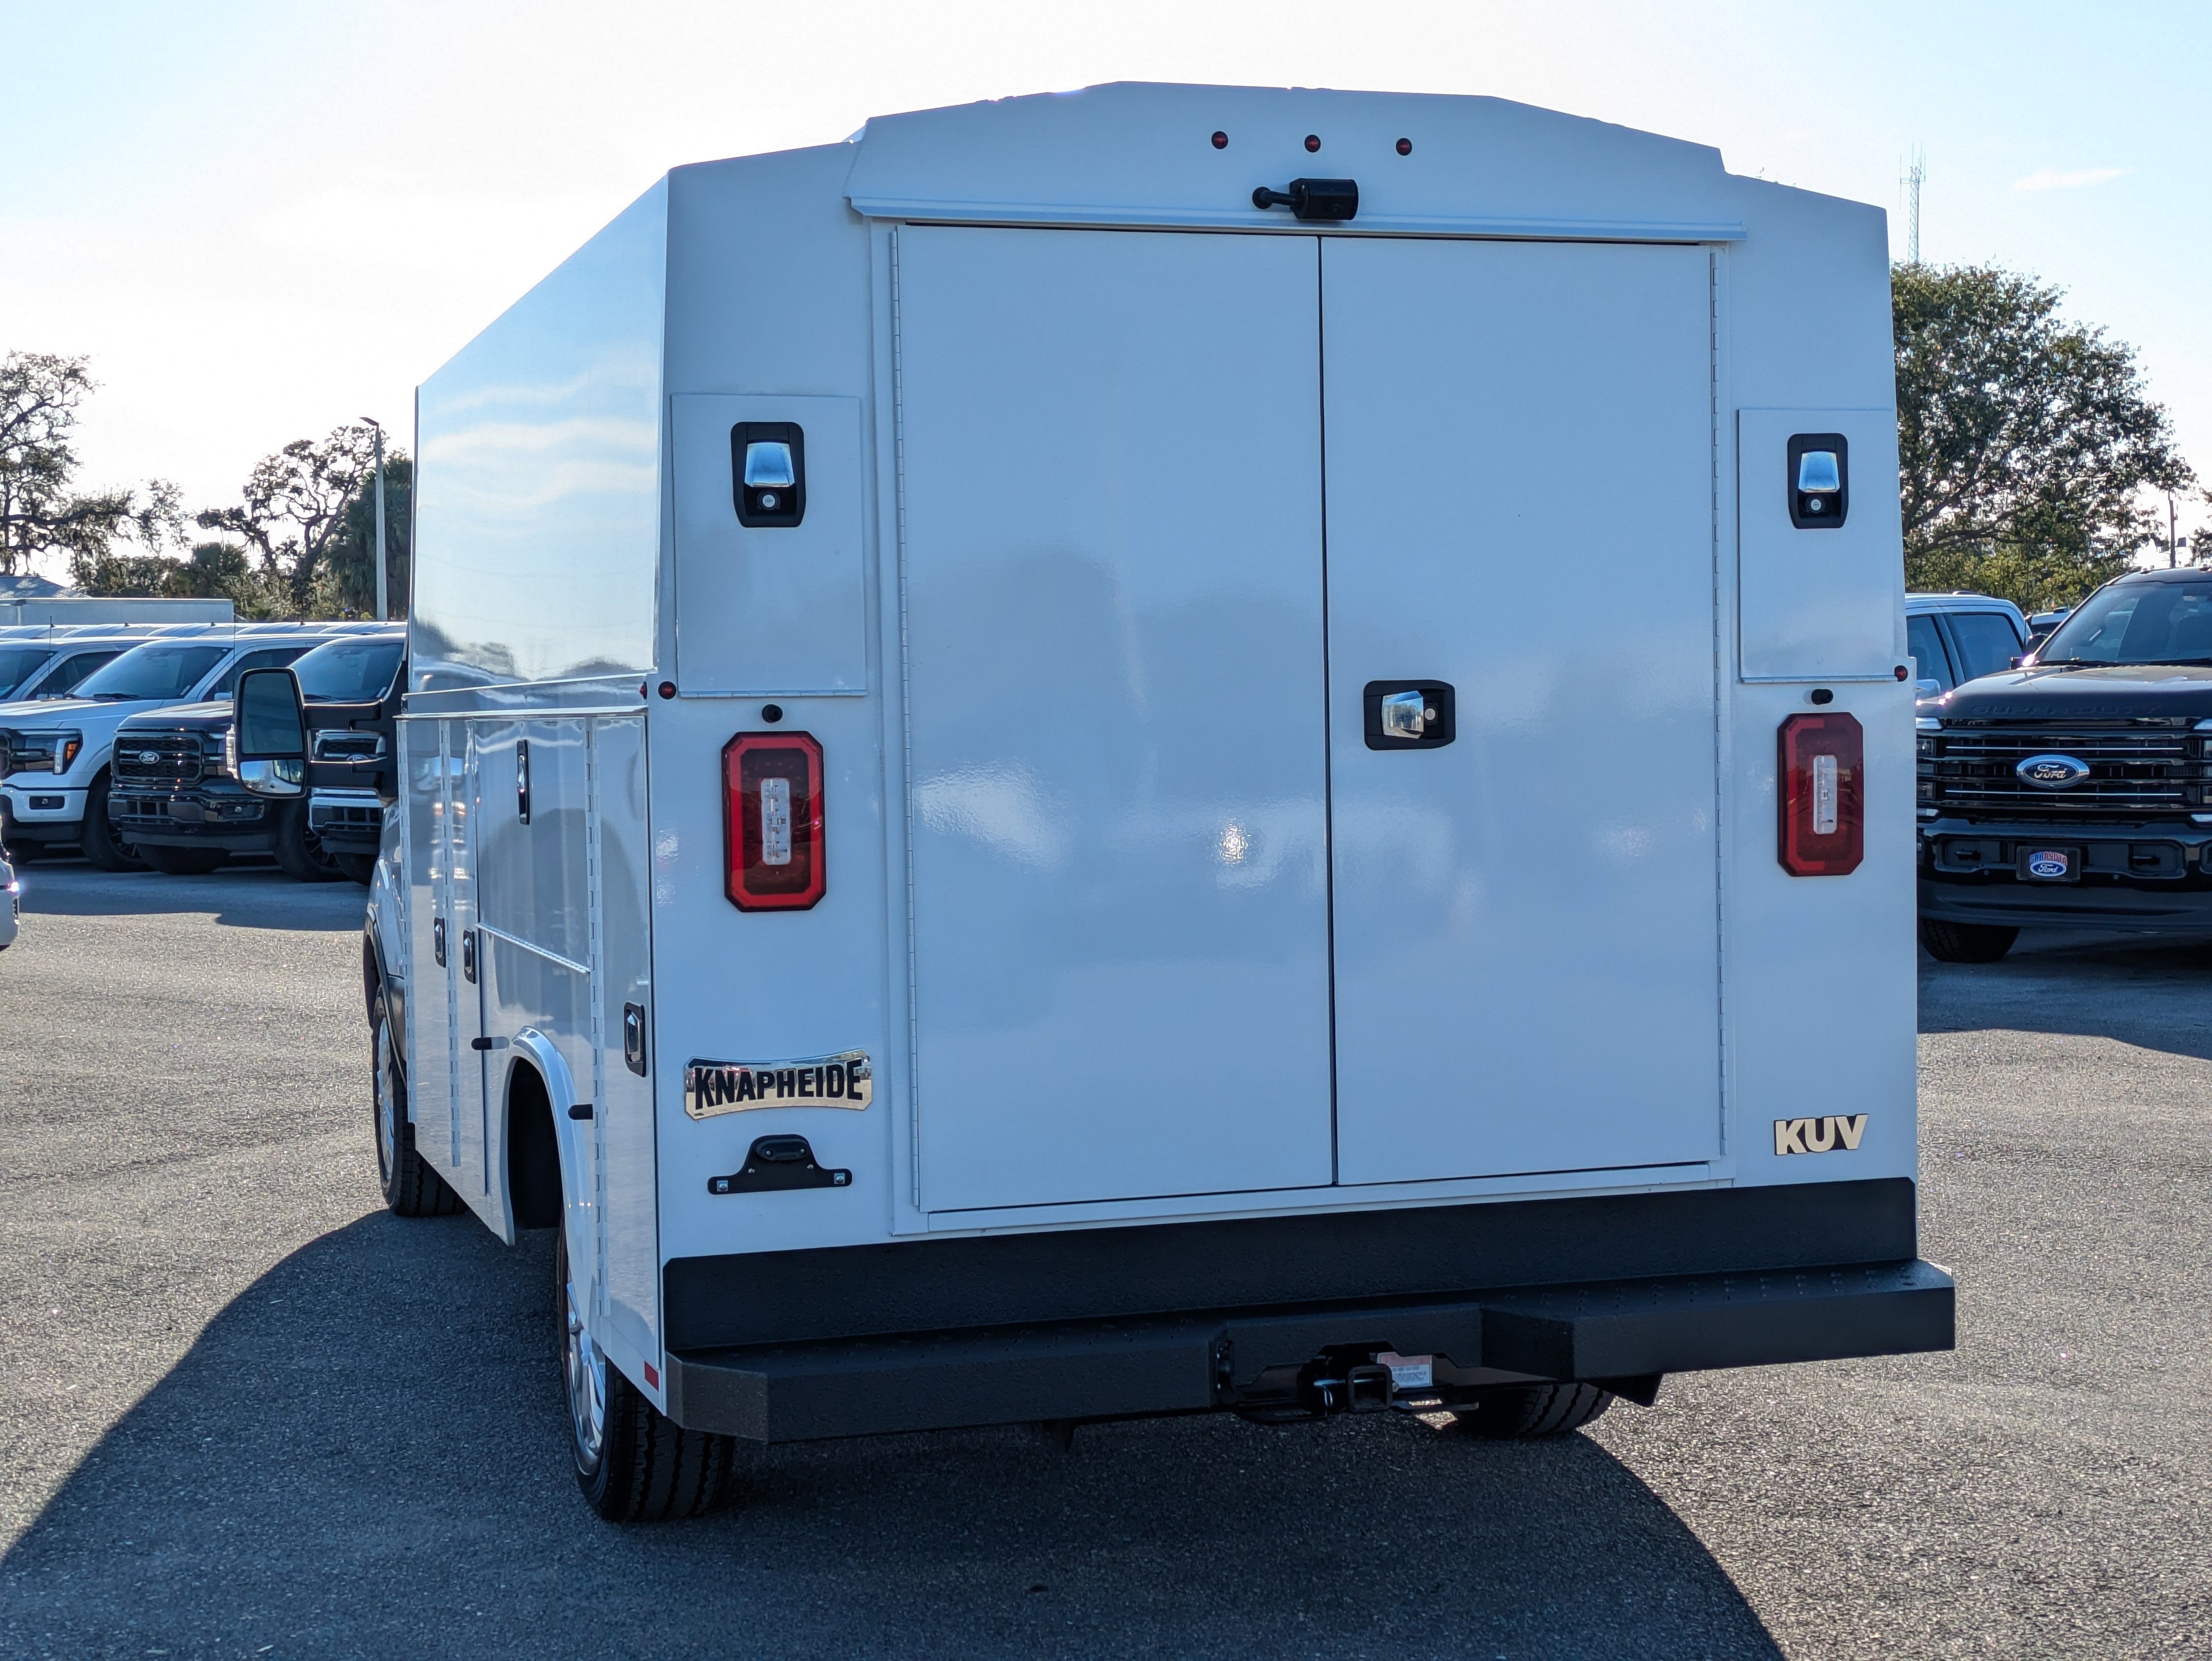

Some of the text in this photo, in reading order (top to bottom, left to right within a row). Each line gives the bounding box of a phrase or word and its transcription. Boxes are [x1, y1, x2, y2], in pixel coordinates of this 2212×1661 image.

[2034, 764, 2068, 779] Ford
[2038, 864, 2059, 873] Ford
[694, 1058, 863, 1110] KNAPHEIDE
[1774, 1113, 1869, 1156] KUV
